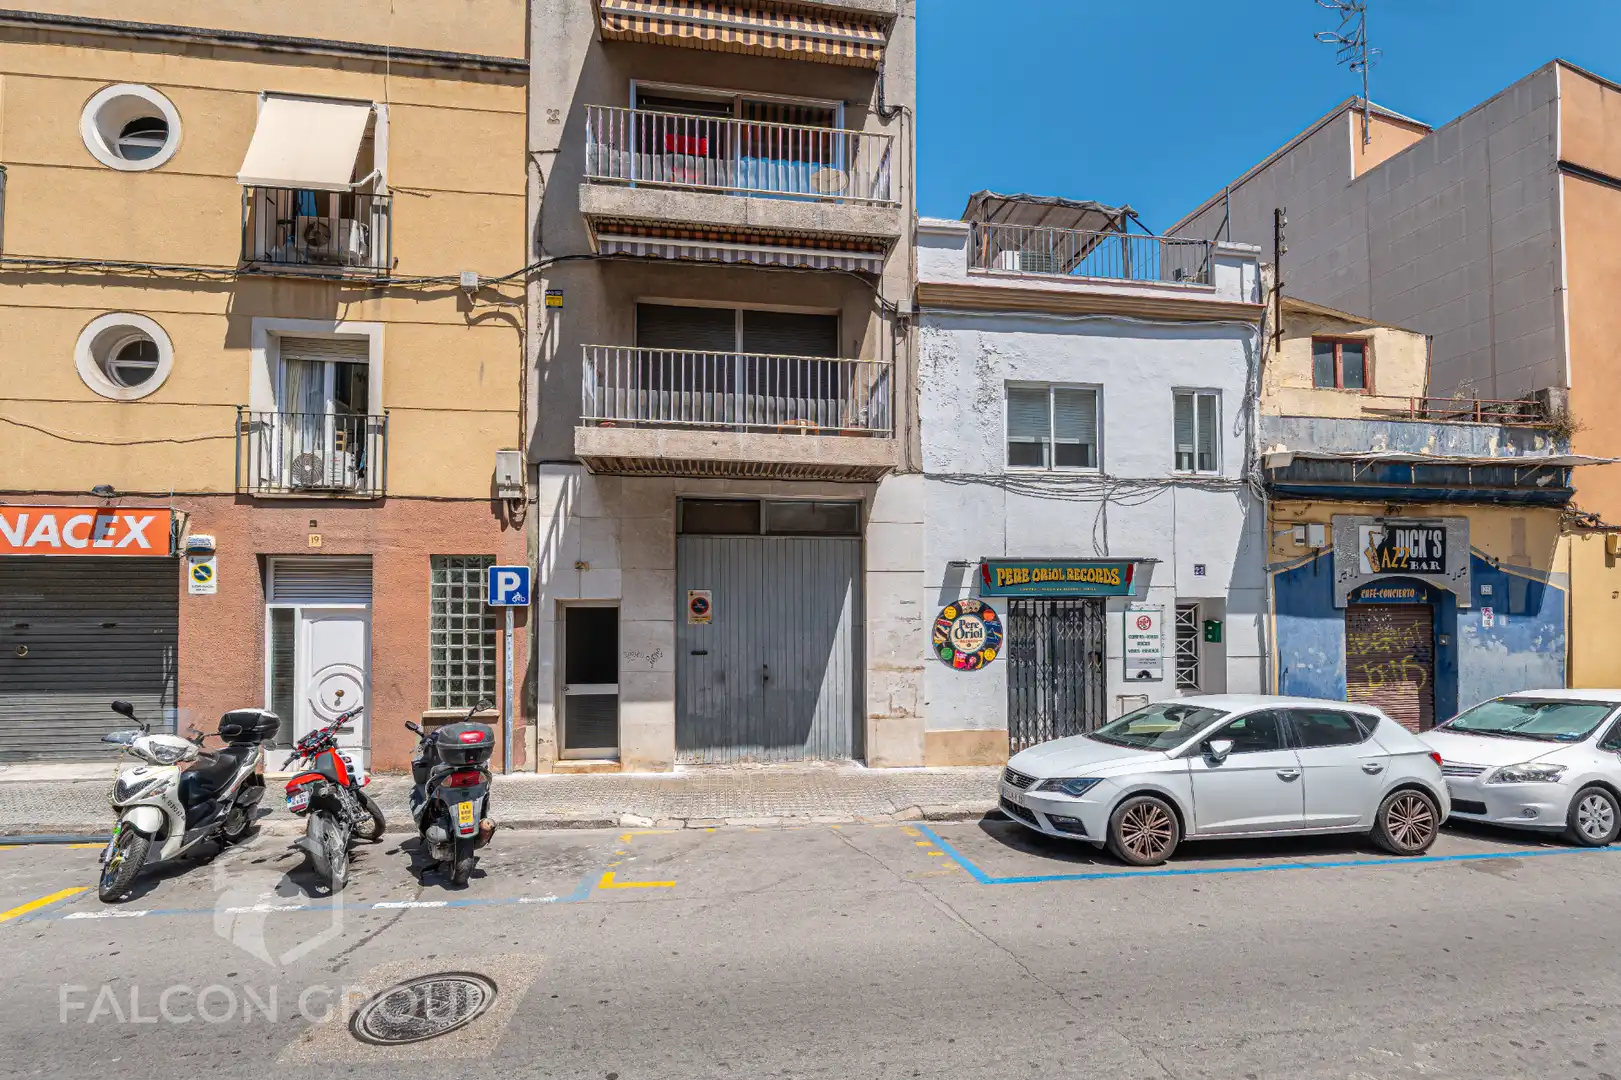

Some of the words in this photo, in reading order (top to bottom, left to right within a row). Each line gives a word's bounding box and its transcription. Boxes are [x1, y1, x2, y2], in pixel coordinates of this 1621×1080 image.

[0, 514, 156, 548] NACEX
[311, 535, 320, 544] 19
[1395, 528, 1442, 558] DICK'S
[1409, 560, 1441, 570] BAR
[996, 567, 1030, 587] PERE
[1066, 567, 1120, 586] RECORDS
[497, 571, 521, 601] P
[958, 619, 980, 631] Pere
[954, 627, 983, 640] Oriol
